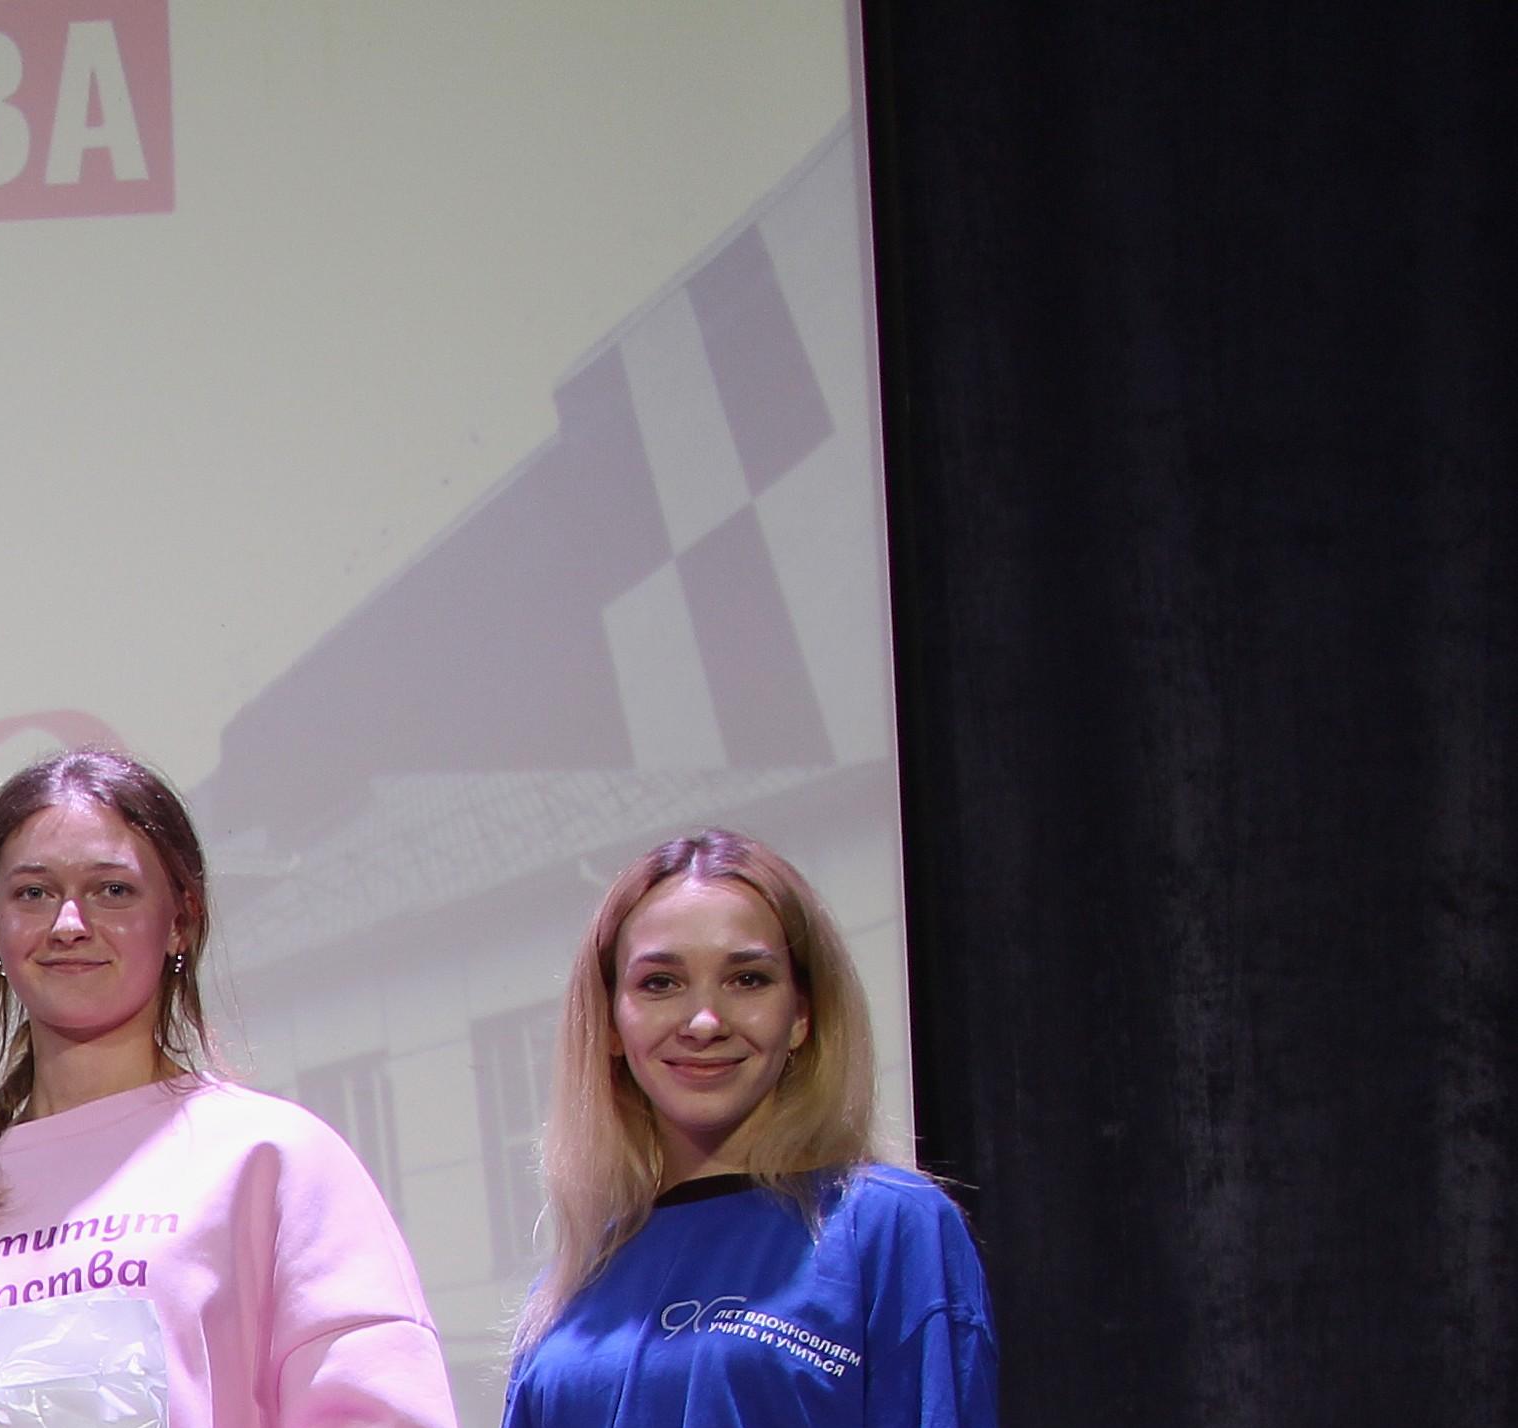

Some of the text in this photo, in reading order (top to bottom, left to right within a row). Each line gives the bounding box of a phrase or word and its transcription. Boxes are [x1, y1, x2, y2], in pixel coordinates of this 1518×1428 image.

[708, 1321, 846, 1377] УЧИТЬ И УЧИТЬСЯ
[714, 1309, 744, 1321] ЛЕТ
[744, 1310, 862, 1367] ВДОХНОВЛЯЕМ
